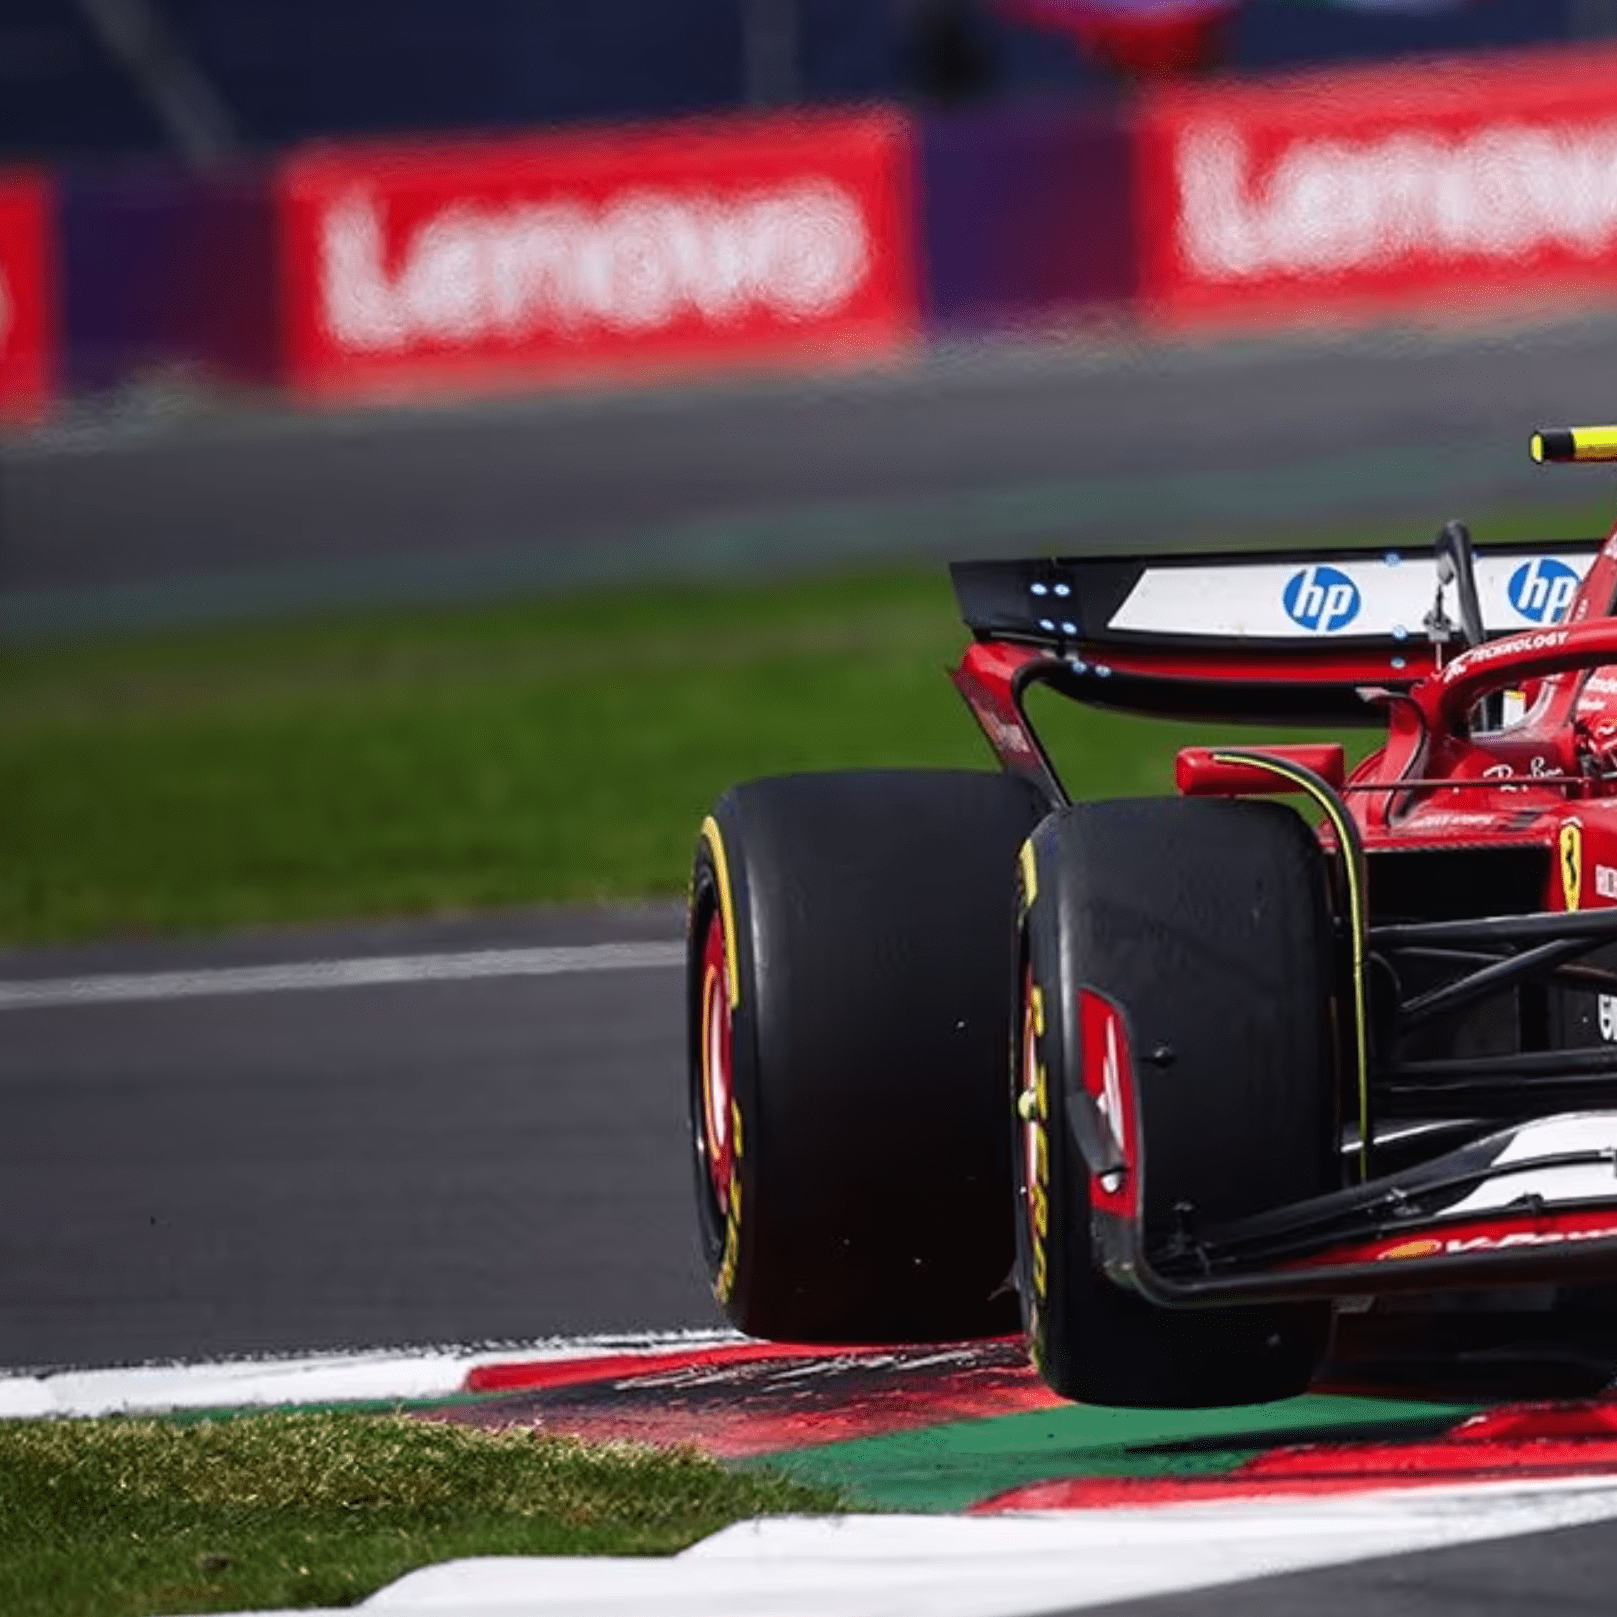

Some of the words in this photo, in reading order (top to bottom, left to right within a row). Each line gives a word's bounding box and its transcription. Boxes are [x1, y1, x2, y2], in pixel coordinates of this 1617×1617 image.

[320, 177, 870, 352] Lenovo
[1291, 563, 1354, 632] hp
[1514, 557, 1578, 624] hp
